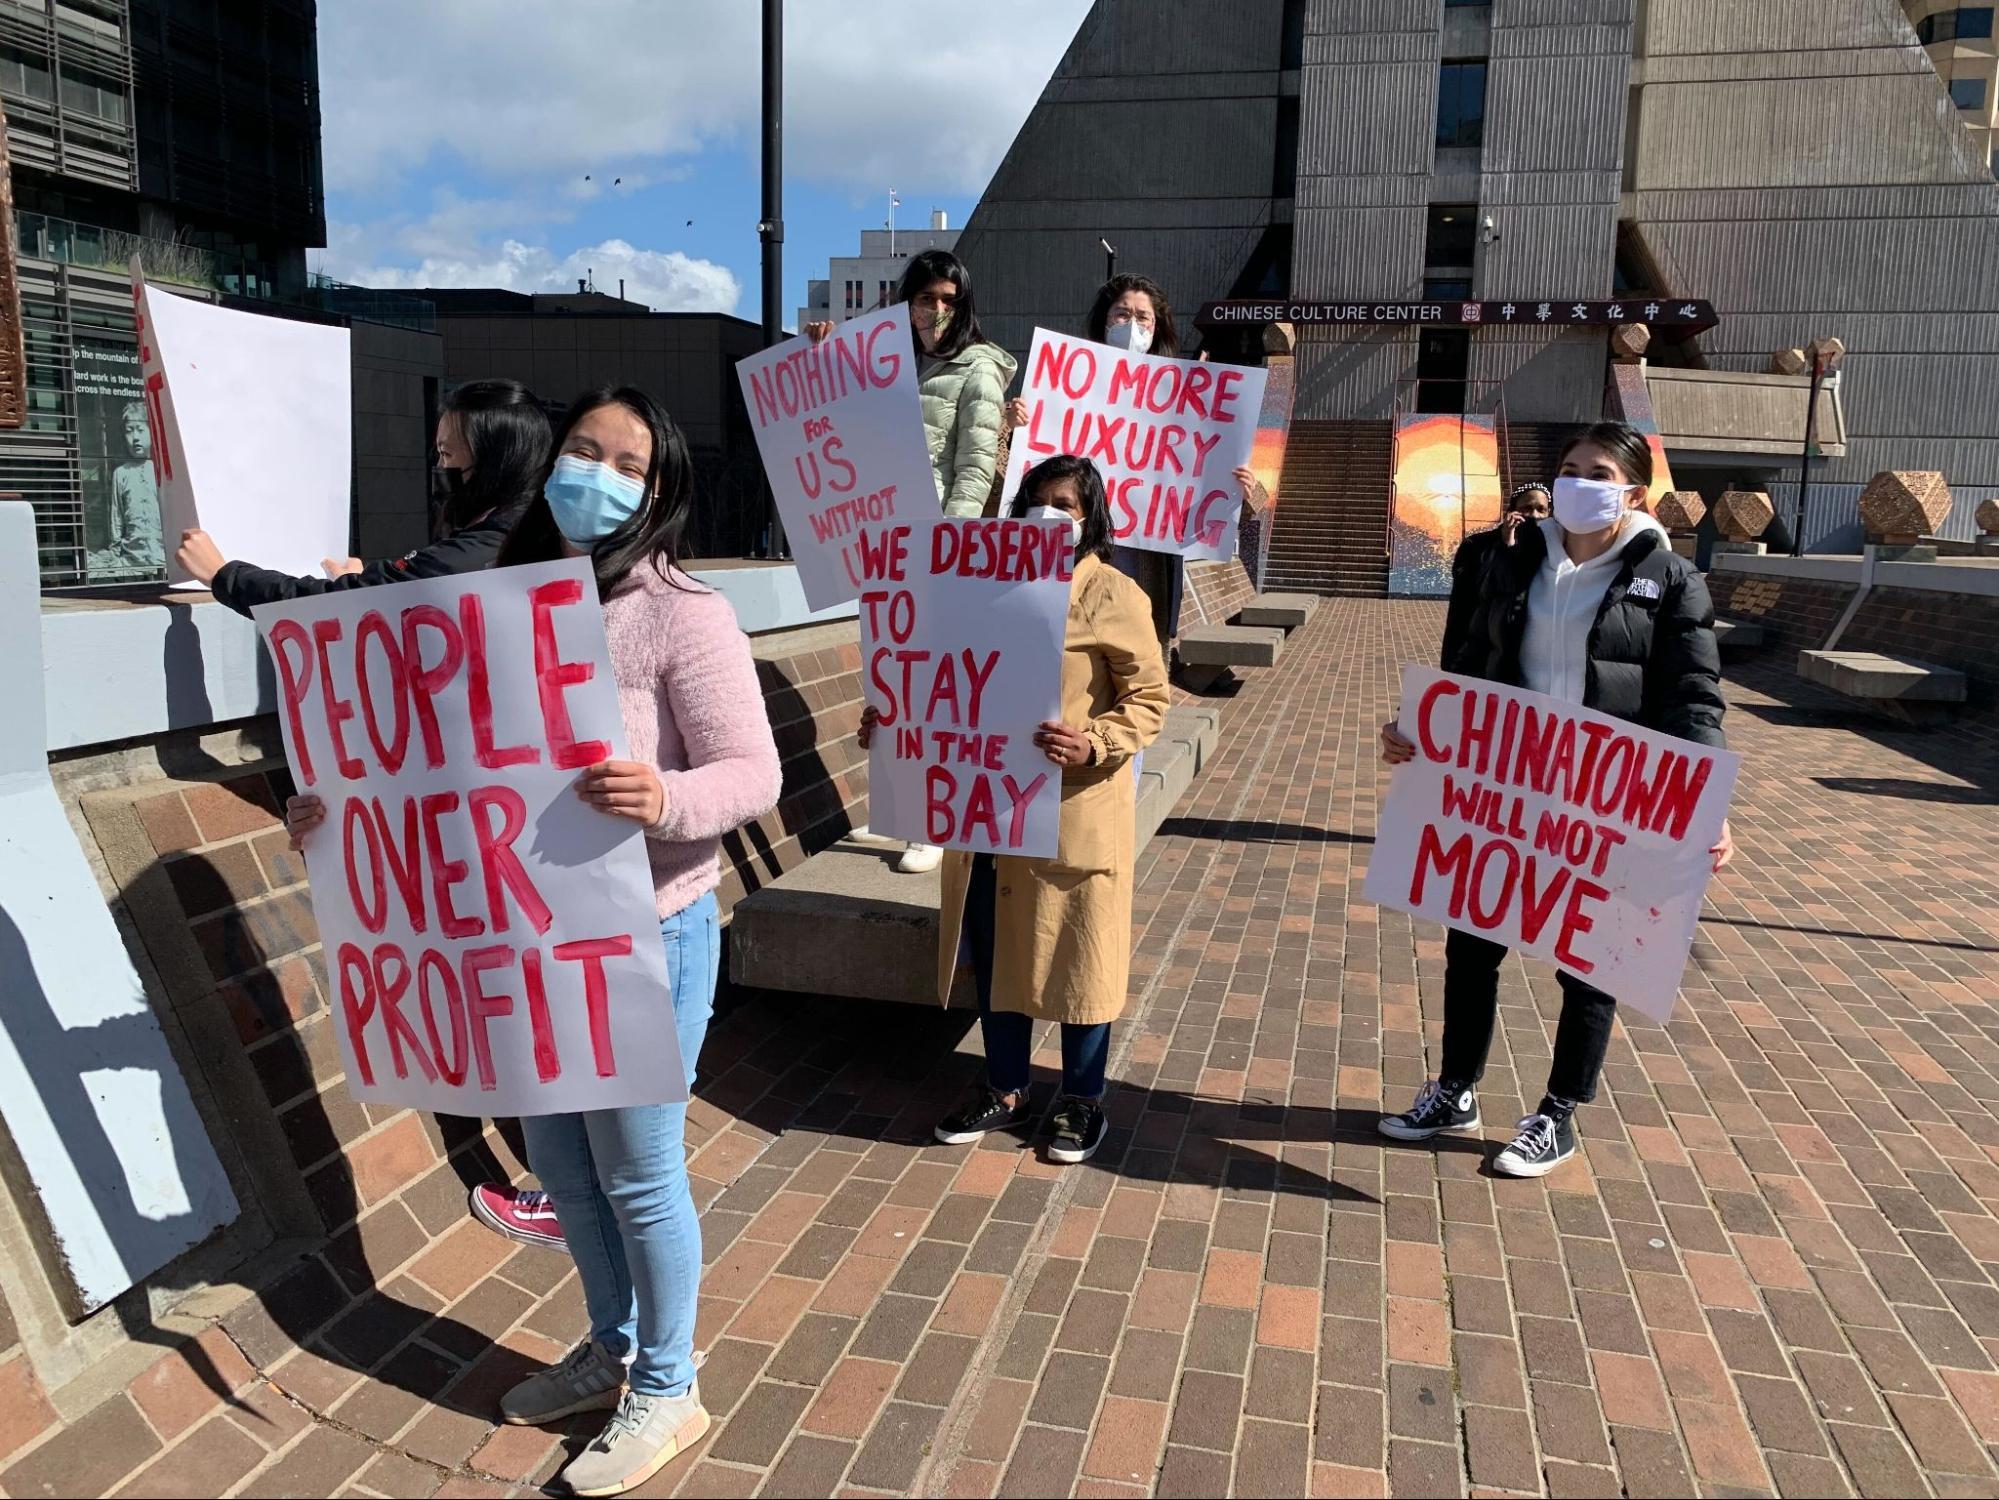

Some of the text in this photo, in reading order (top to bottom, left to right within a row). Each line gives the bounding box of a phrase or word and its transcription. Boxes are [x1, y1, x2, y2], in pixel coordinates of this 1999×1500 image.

[1212, 306, 1442, 320] CHINESE CULTURE CENTER
[1502, 303, 1697, 321] 中華文化中心
[81, 349, 94, 360] the
[95, 352, 130, 364] mountain
[130, 356, 139, 365] of
[90, 373, 109, 383] work
[110, 374, 117, 384] is
[118, 375, 130, 385] the
[99, 386, 112, 395] the
[113, 388, 140, 398] endless
[750, 320, 900, 428] NOTHING
[1032, 341, 1245, 423] NO MORE
[794, 436, 857, 500] US
[803, 416, 833, 444] FOR
[1028, 399, 1222, 478] LUXURY
[858, 521, 1075, 582] WE DESERVE
[861, 590, 915, 645] TO
[270, 579, 613, 786] PEOPLE
[870, 647, 1000, 729] STAY
[896, 727, 1008, 770] IN THE
[1418, 680, 1713, 842] CHINATOWN
[926, 765, 1048, 848] BAY
[1442, 774, 1626, 877] WILL NOT
[343, 785, 552, 939] OVER
[1409, 824, 1610, 974] MOVE
[338, 934, 632, 1091] PROFIT
